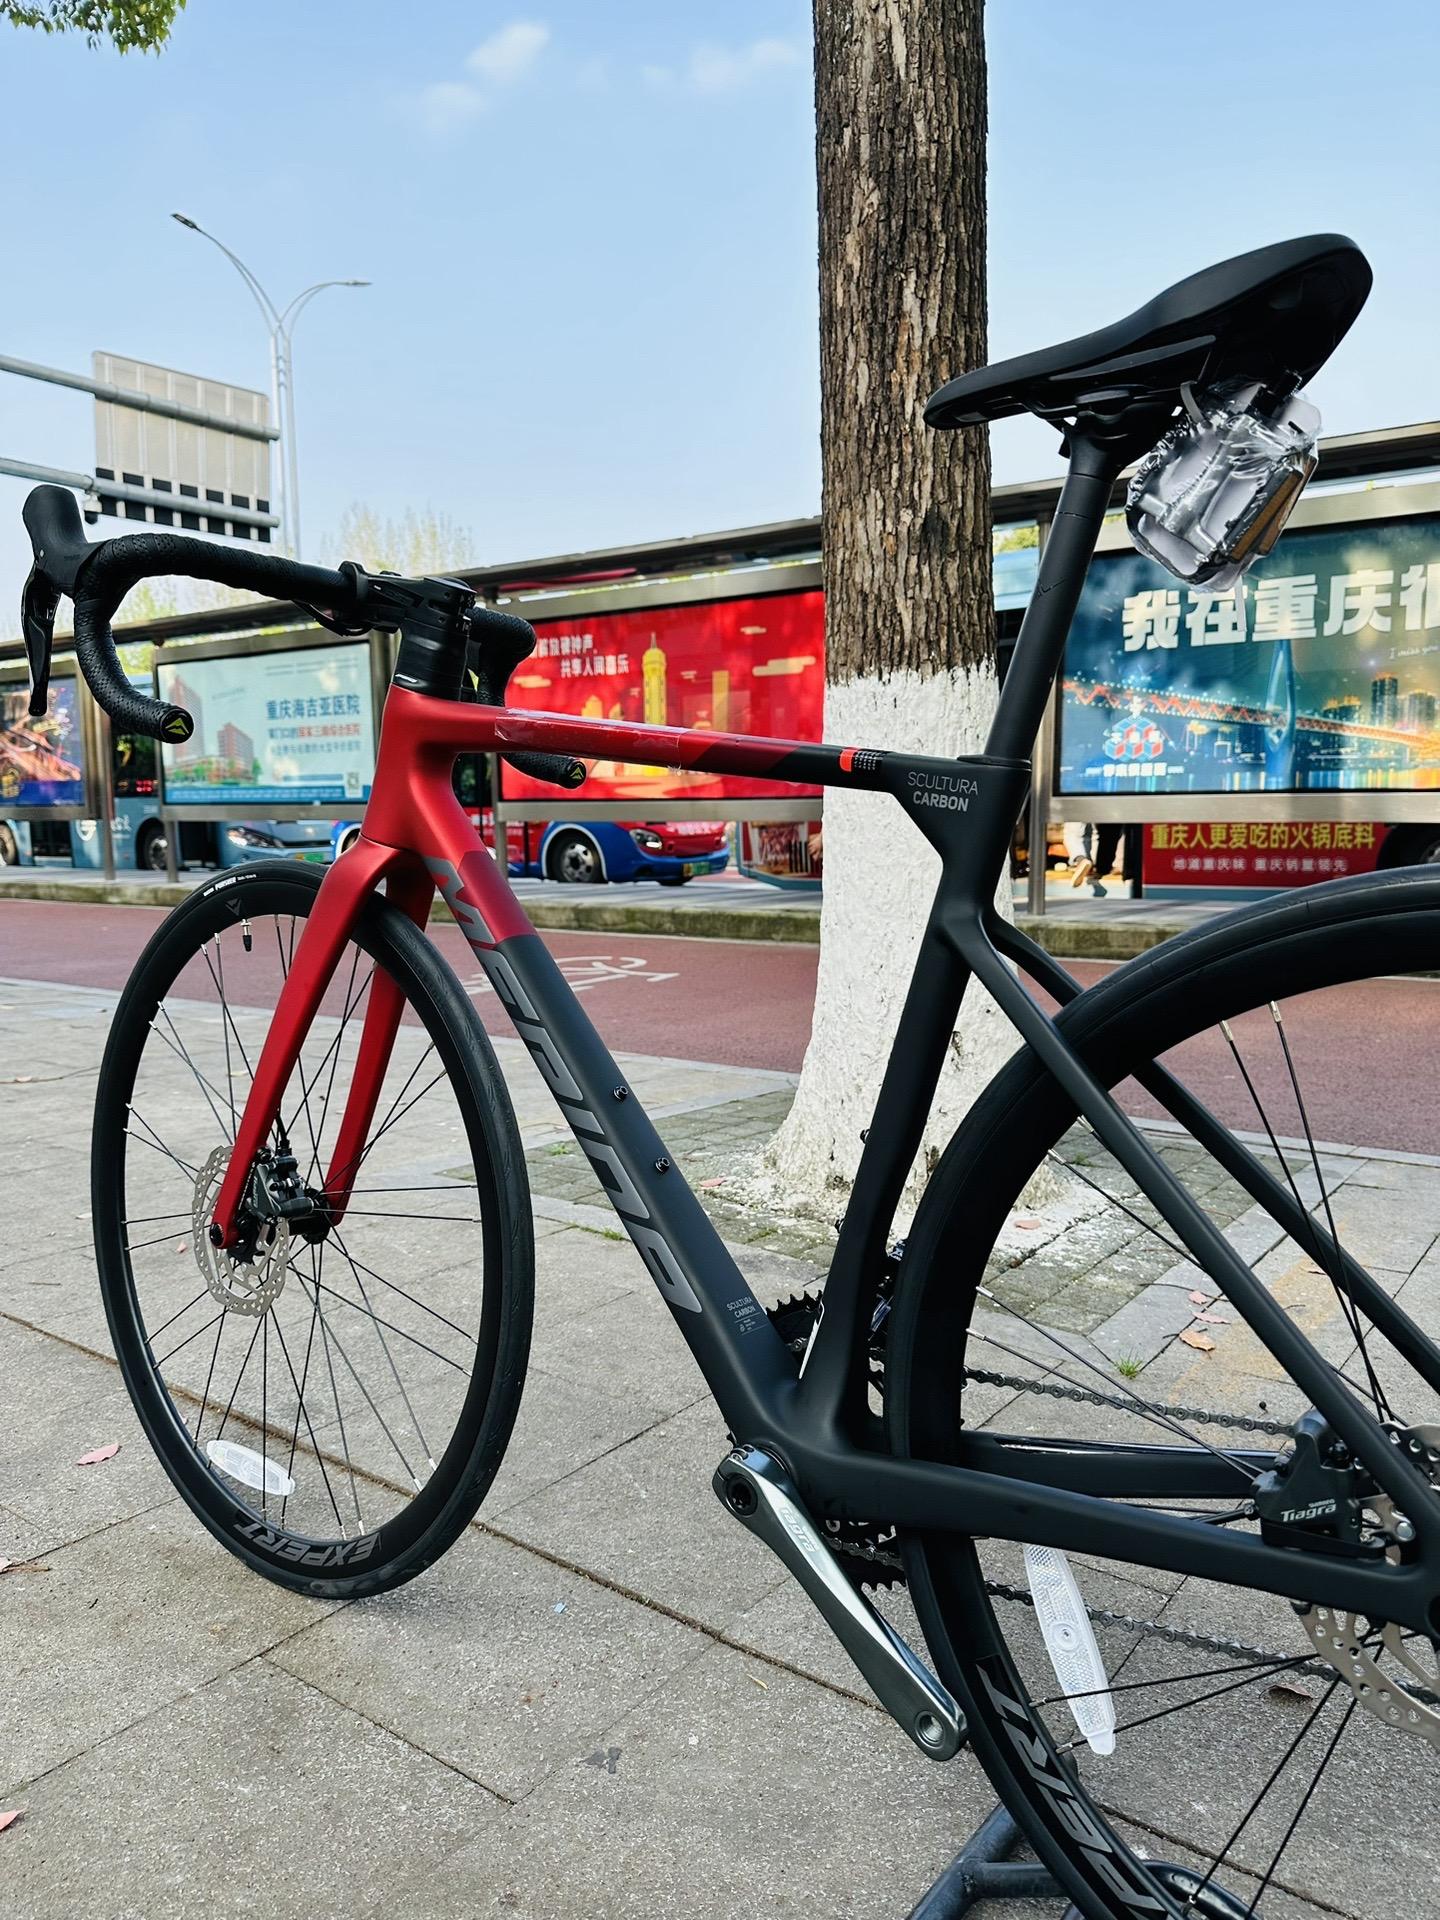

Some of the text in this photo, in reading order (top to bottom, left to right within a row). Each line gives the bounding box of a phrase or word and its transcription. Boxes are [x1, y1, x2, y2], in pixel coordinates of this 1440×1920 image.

[266, 694, 360, 720] 重庆海吉亚医院
[907, 771, 979, 795] SCULTURA
[913, 791, 969, 812] CARBON
[1151, 823, 1375, 849] 重庆人更爱吃的火锅底料
[1280, 1503, 1337, 1522] Tiagra
[233, 1521, 381, 1567] EXPERT
[976, 1663, 1172, 1920] PERT
